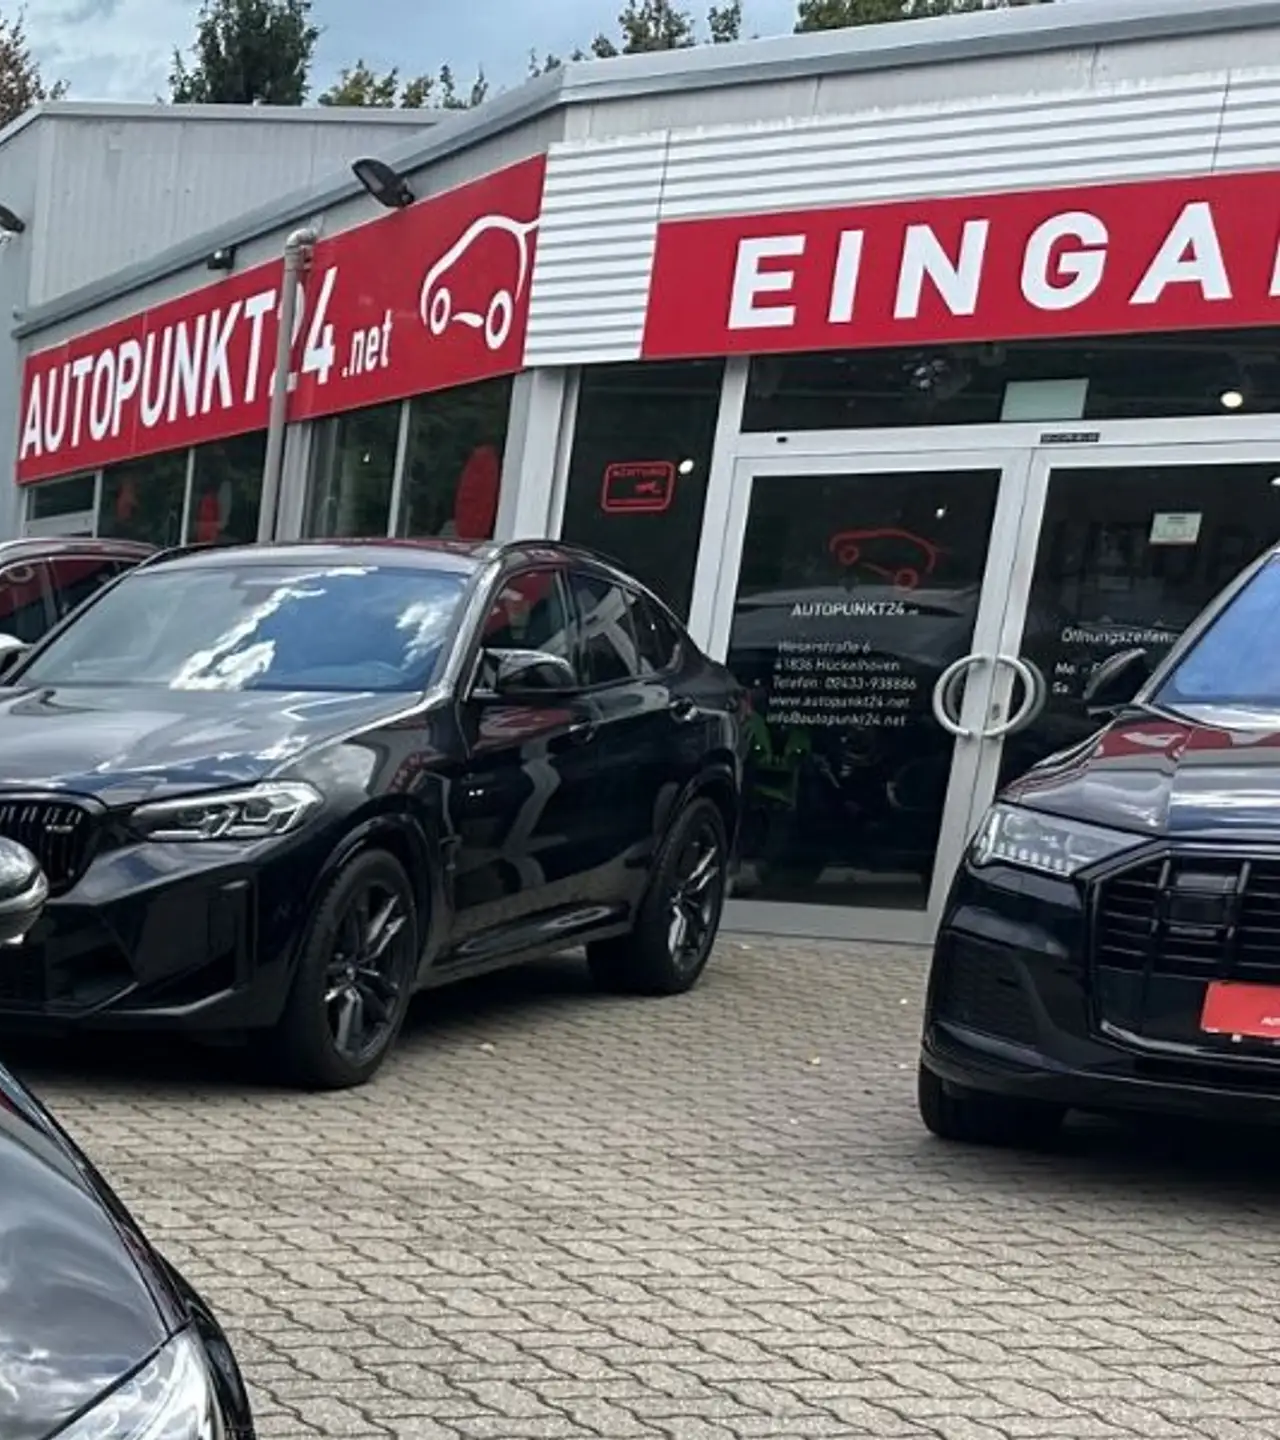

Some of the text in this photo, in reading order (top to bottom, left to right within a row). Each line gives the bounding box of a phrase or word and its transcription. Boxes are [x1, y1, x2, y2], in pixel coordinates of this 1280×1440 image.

[728, 201, 1280, 330] EINGA
[342, 309, 393, 378] .net
[791, 602, 905, 617] AUTOPUNKT24
